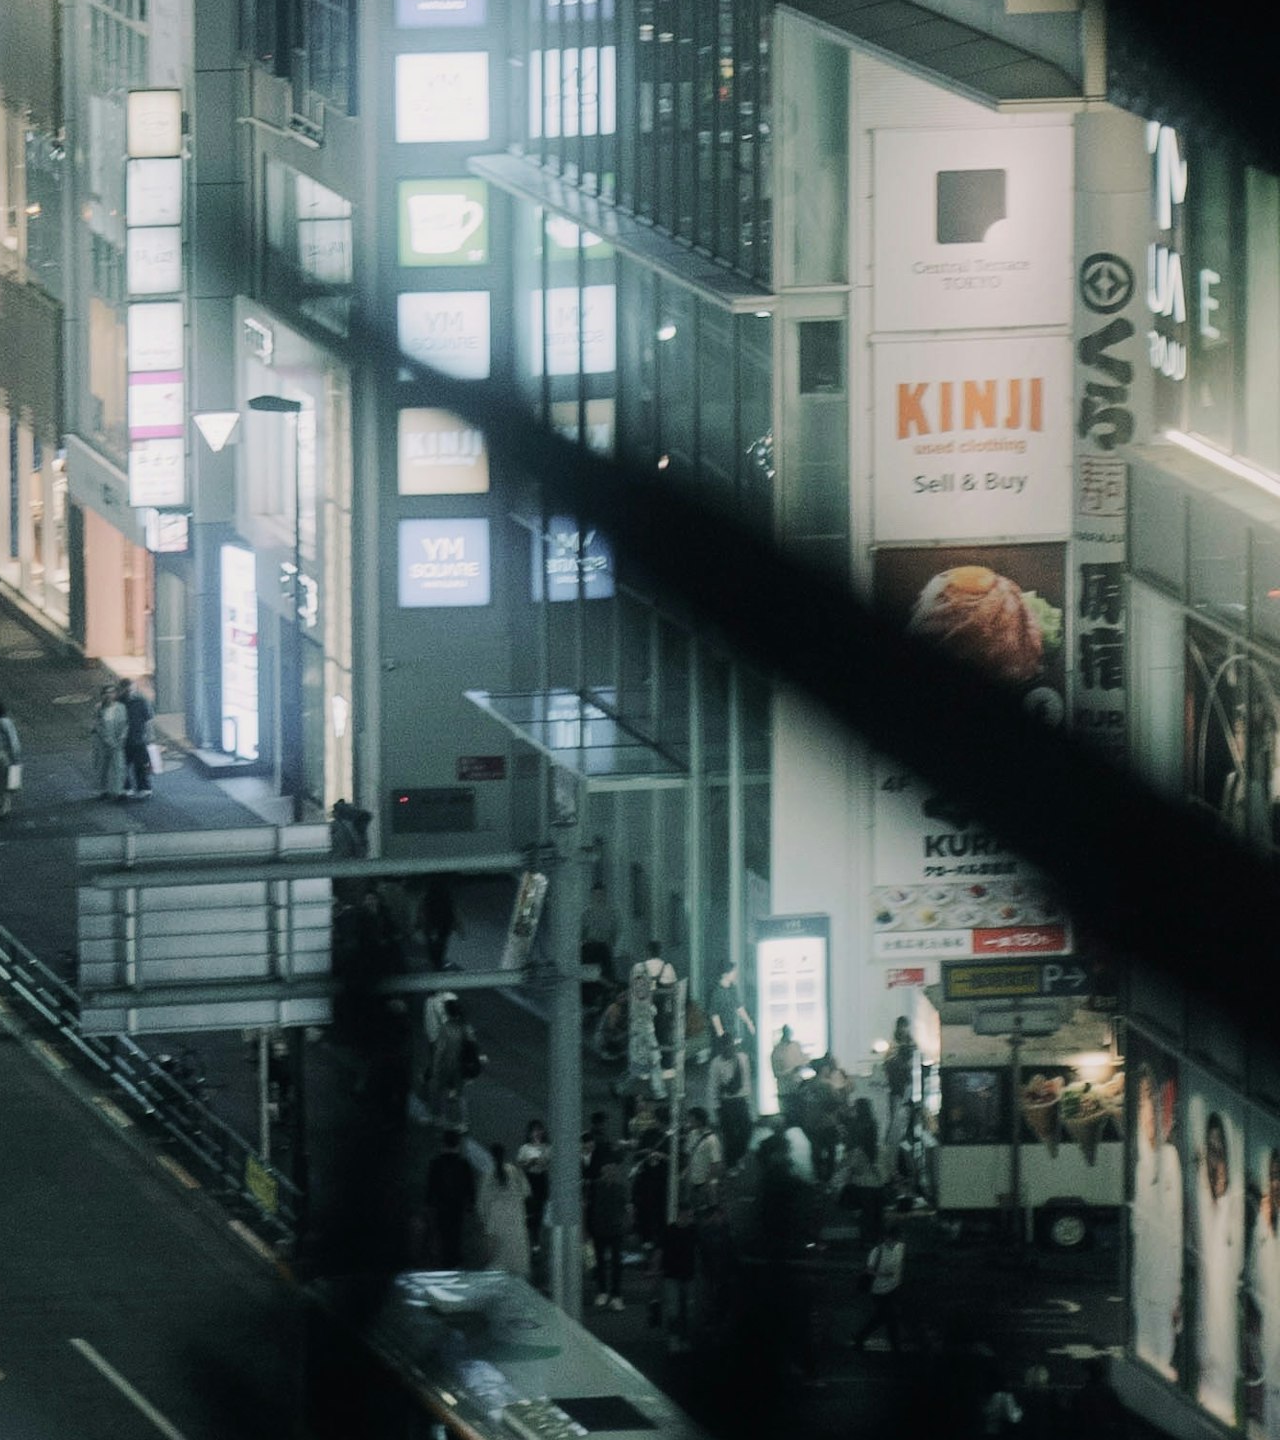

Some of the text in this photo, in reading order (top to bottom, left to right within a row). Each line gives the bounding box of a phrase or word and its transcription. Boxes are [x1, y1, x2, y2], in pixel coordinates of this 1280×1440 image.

[897, 377, 1046, 440] KINJI
[913, 471, 1029, 495] Sell & Buy
[421, 536, 465, 560] YM
[409, 562, 480, 579] SQUARE
[1042, 965, 1064, 993] P
